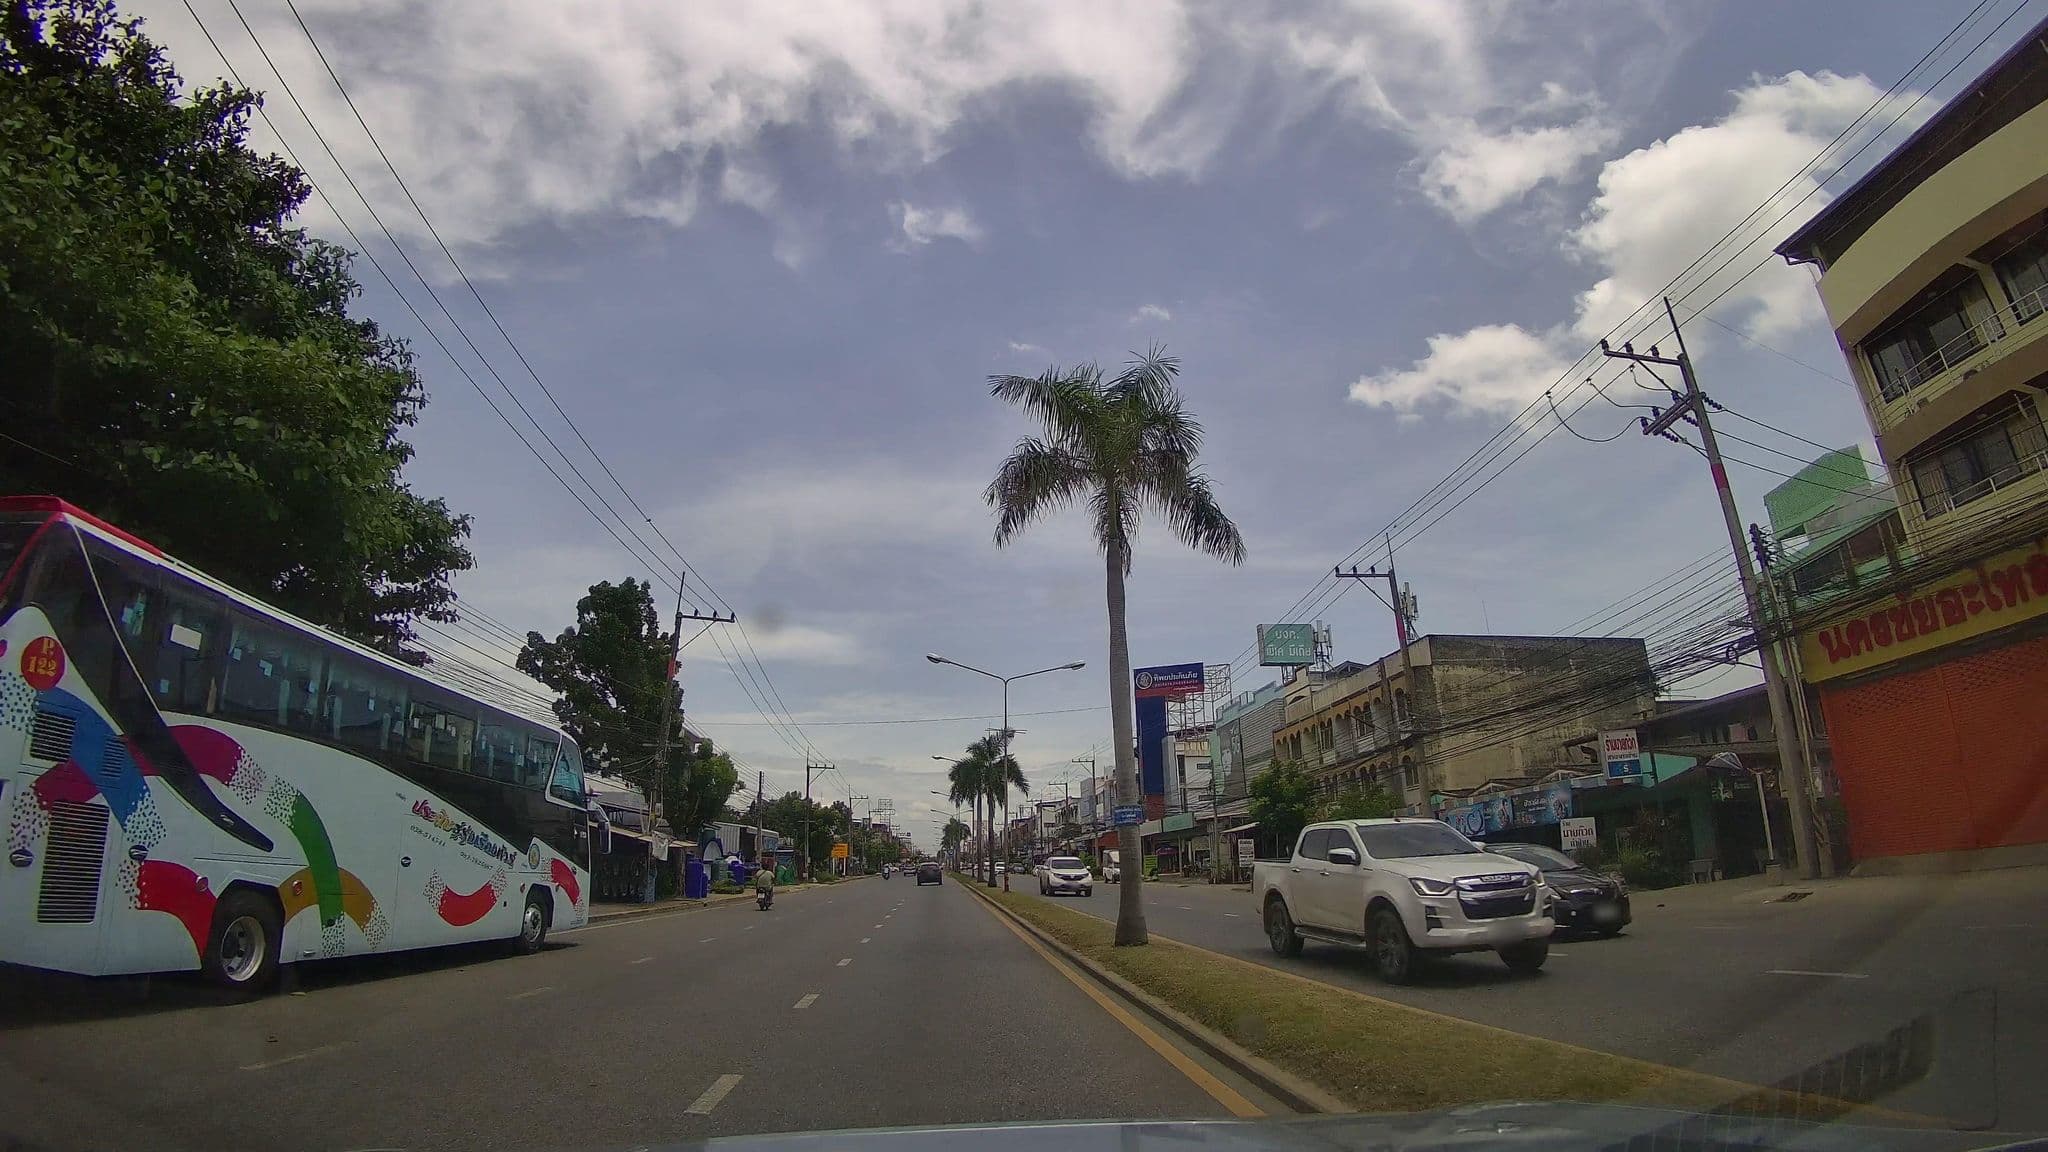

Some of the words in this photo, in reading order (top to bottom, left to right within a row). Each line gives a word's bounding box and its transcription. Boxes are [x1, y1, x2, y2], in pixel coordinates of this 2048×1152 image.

[27, 656, 57, 677] 122
[1153, 670, 1198, 683] ทิพยประกันภัย
